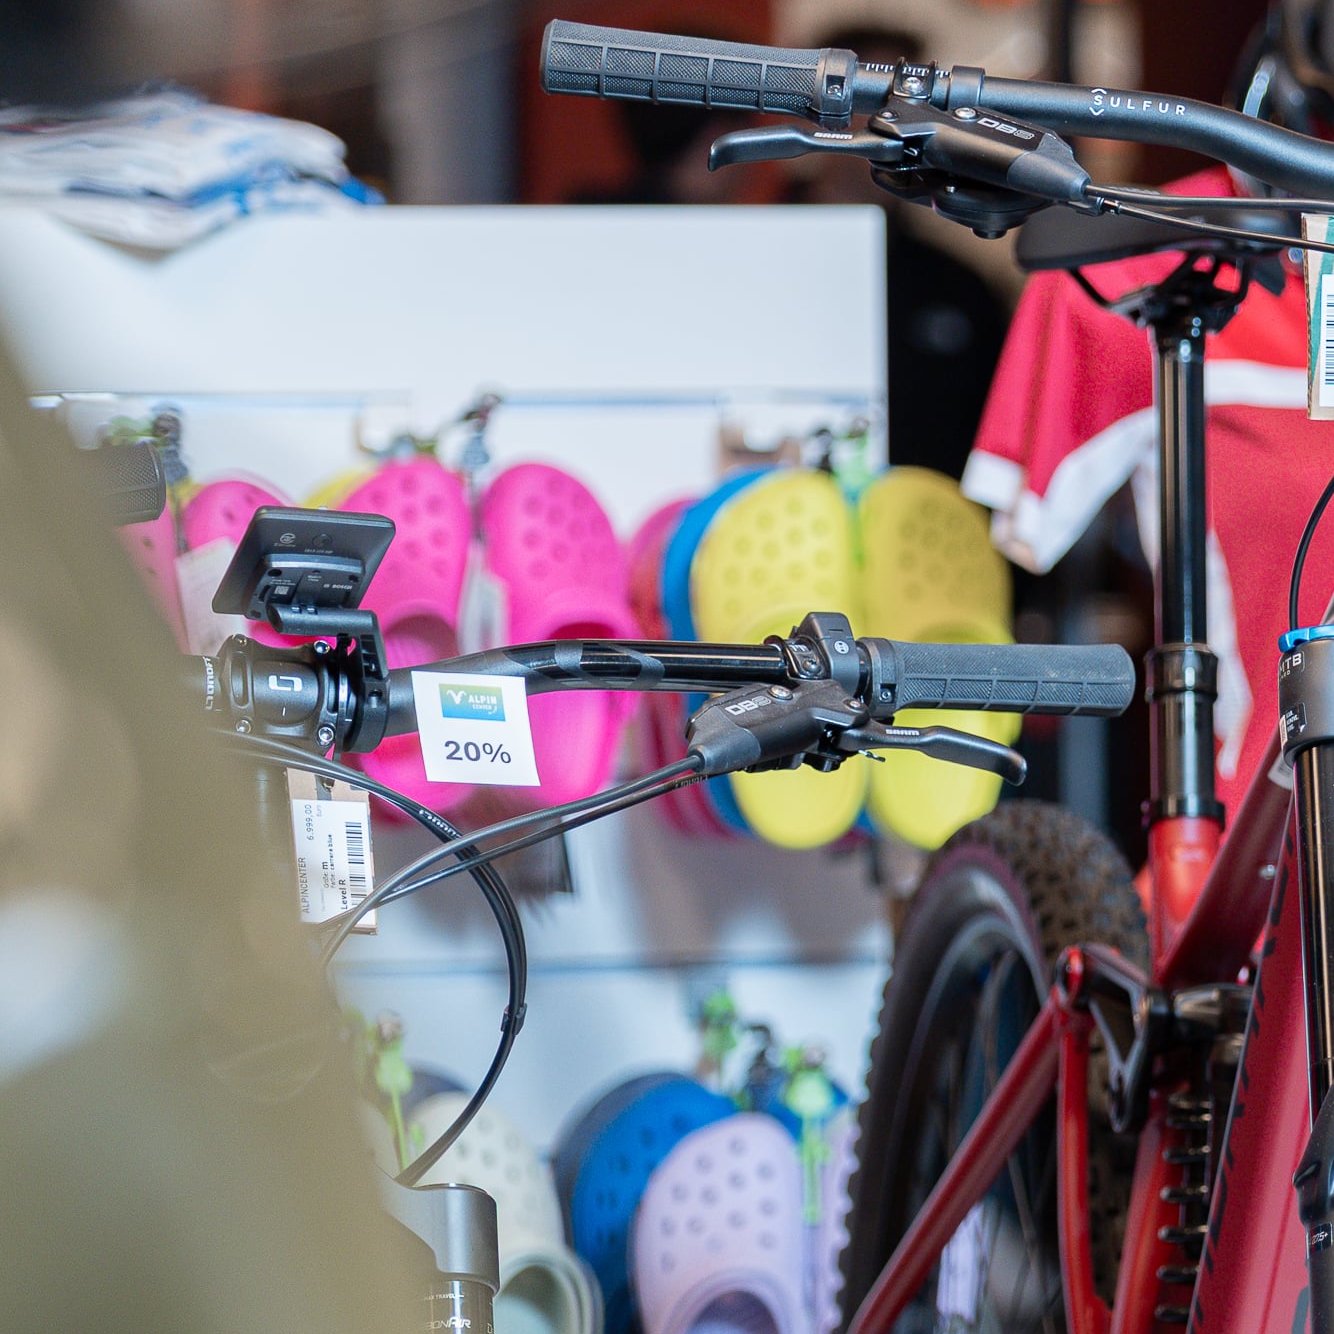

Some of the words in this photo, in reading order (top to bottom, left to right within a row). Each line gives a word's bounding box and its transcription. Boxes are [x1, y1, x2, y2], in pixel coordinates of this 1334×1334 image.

[1093, 94, 1186, 116] SULFUR
[468, 694, 497, 705] ALPIN
[444, 740, 512, 764] 20%
[304, 804, 314, 841] 6.999,00
[298, 856, 310, 914] ALPINCENTER
[338, 878, 346, 886] R
[340, 886, 348, 910] Level
